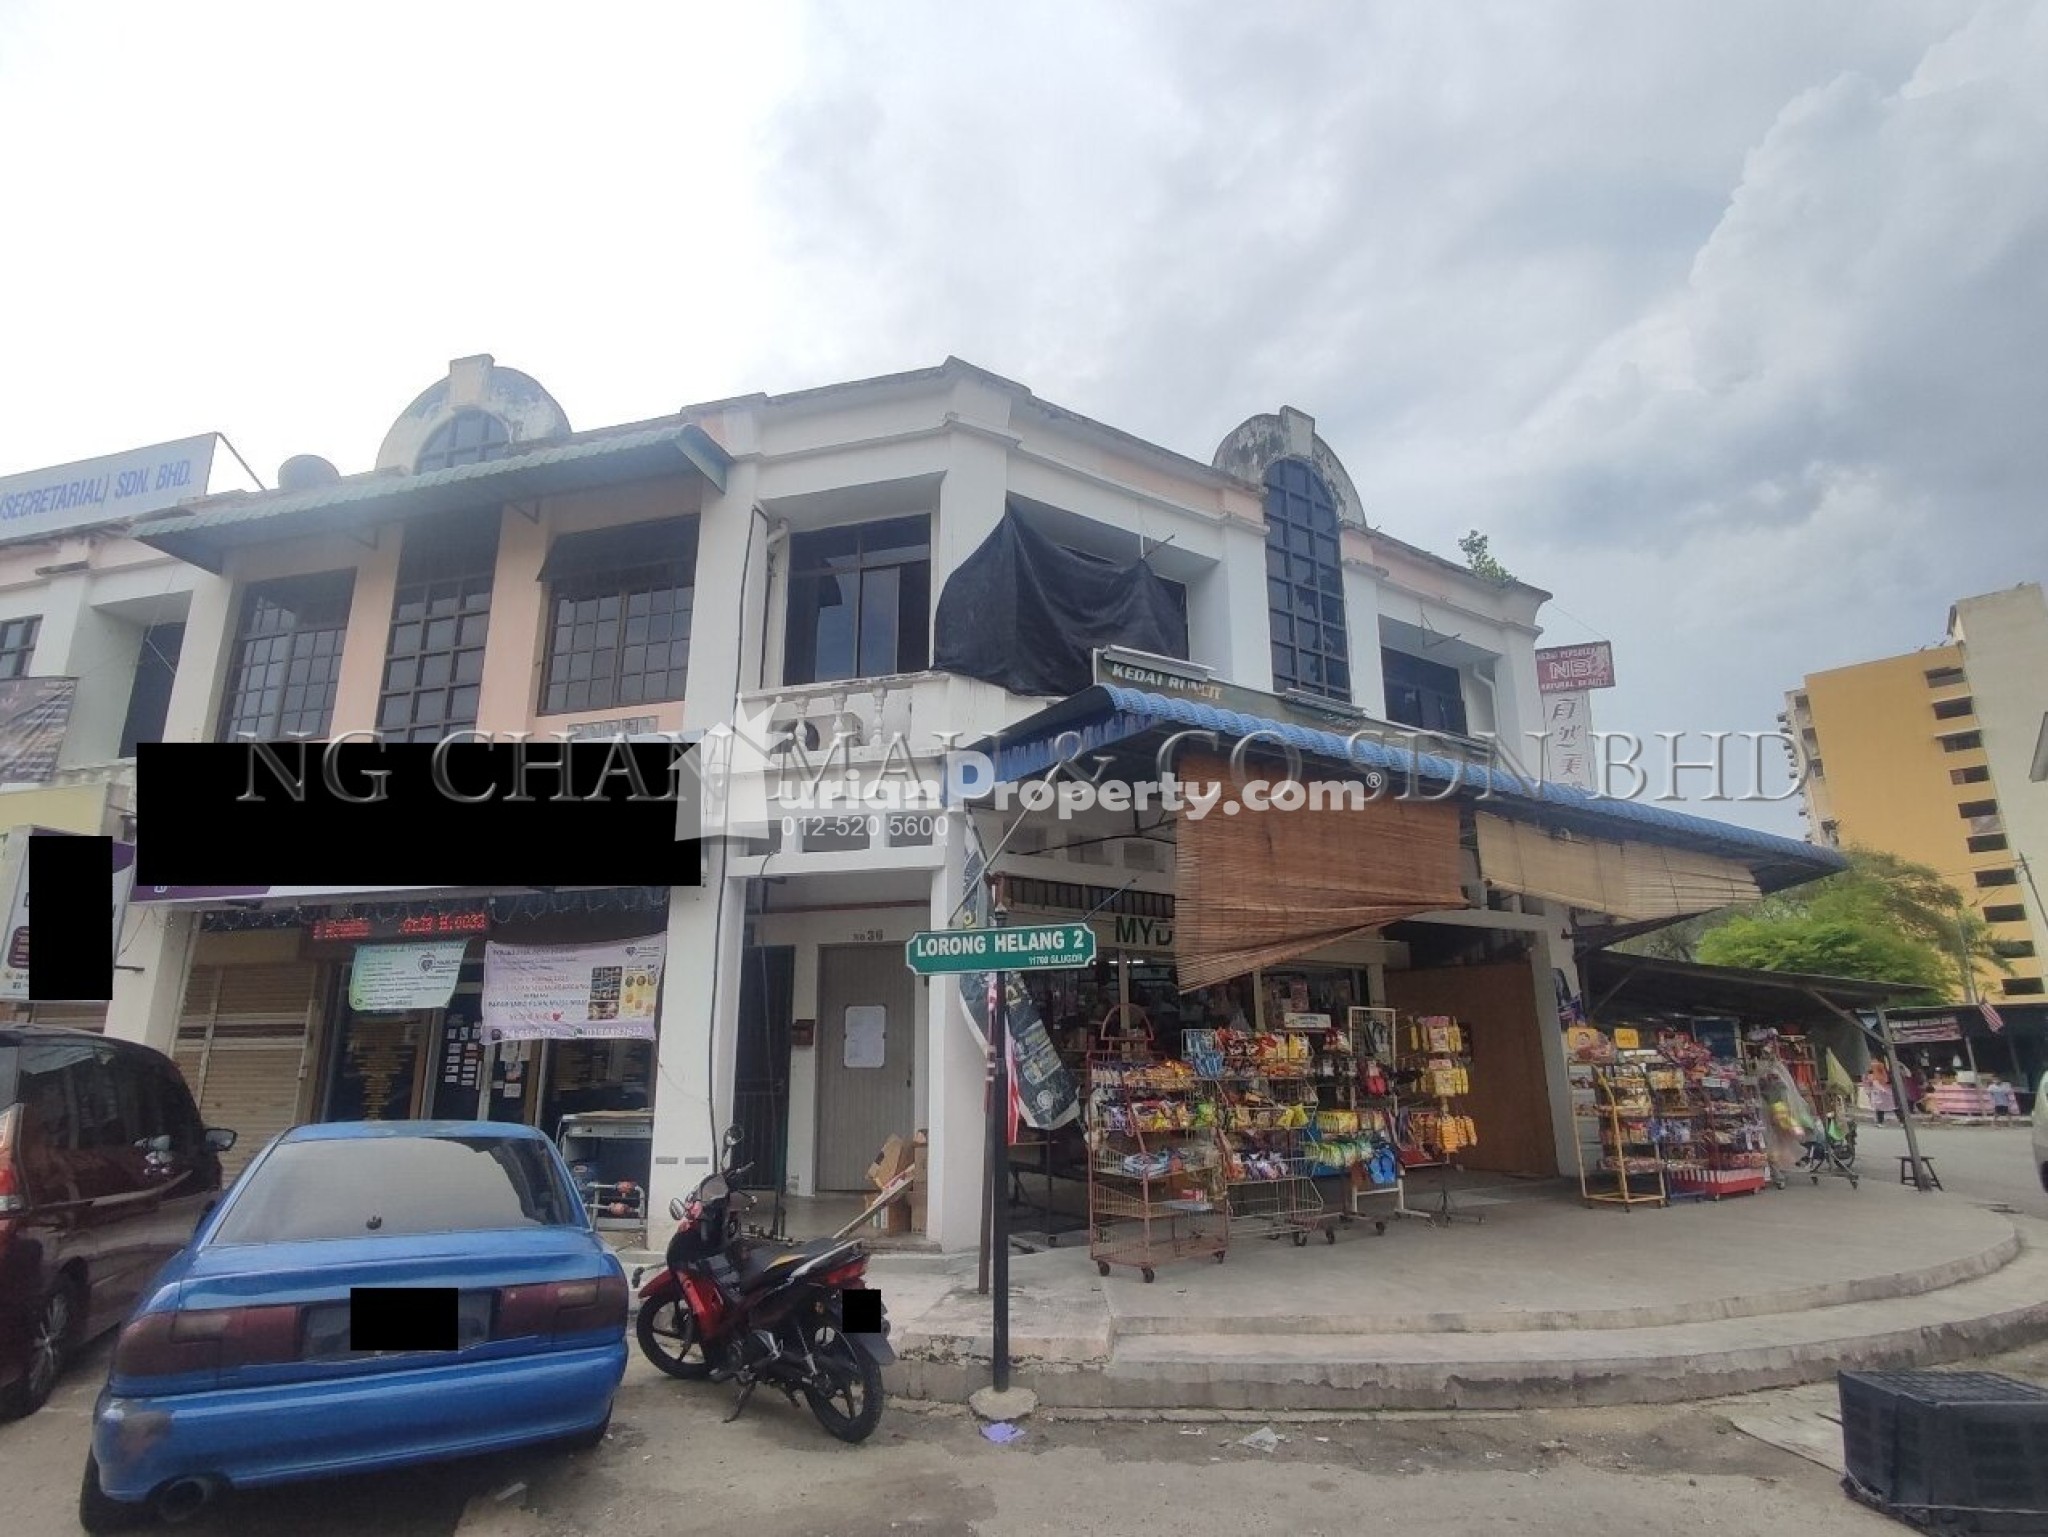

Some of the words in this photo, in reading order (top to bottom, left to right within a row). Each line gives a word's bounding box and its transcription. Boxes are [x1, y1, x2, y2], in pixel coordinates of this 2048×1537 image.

[114, 470, 150, 499] SDN.
[155, 459, 192, 490] BHD.
[1112, 663, 1162, 686] KEDAI
[917, 935, 986, 957] LORONG
[995, 930, 1065, 953] HELANG
[1073, 928, 1084, 948] 2
